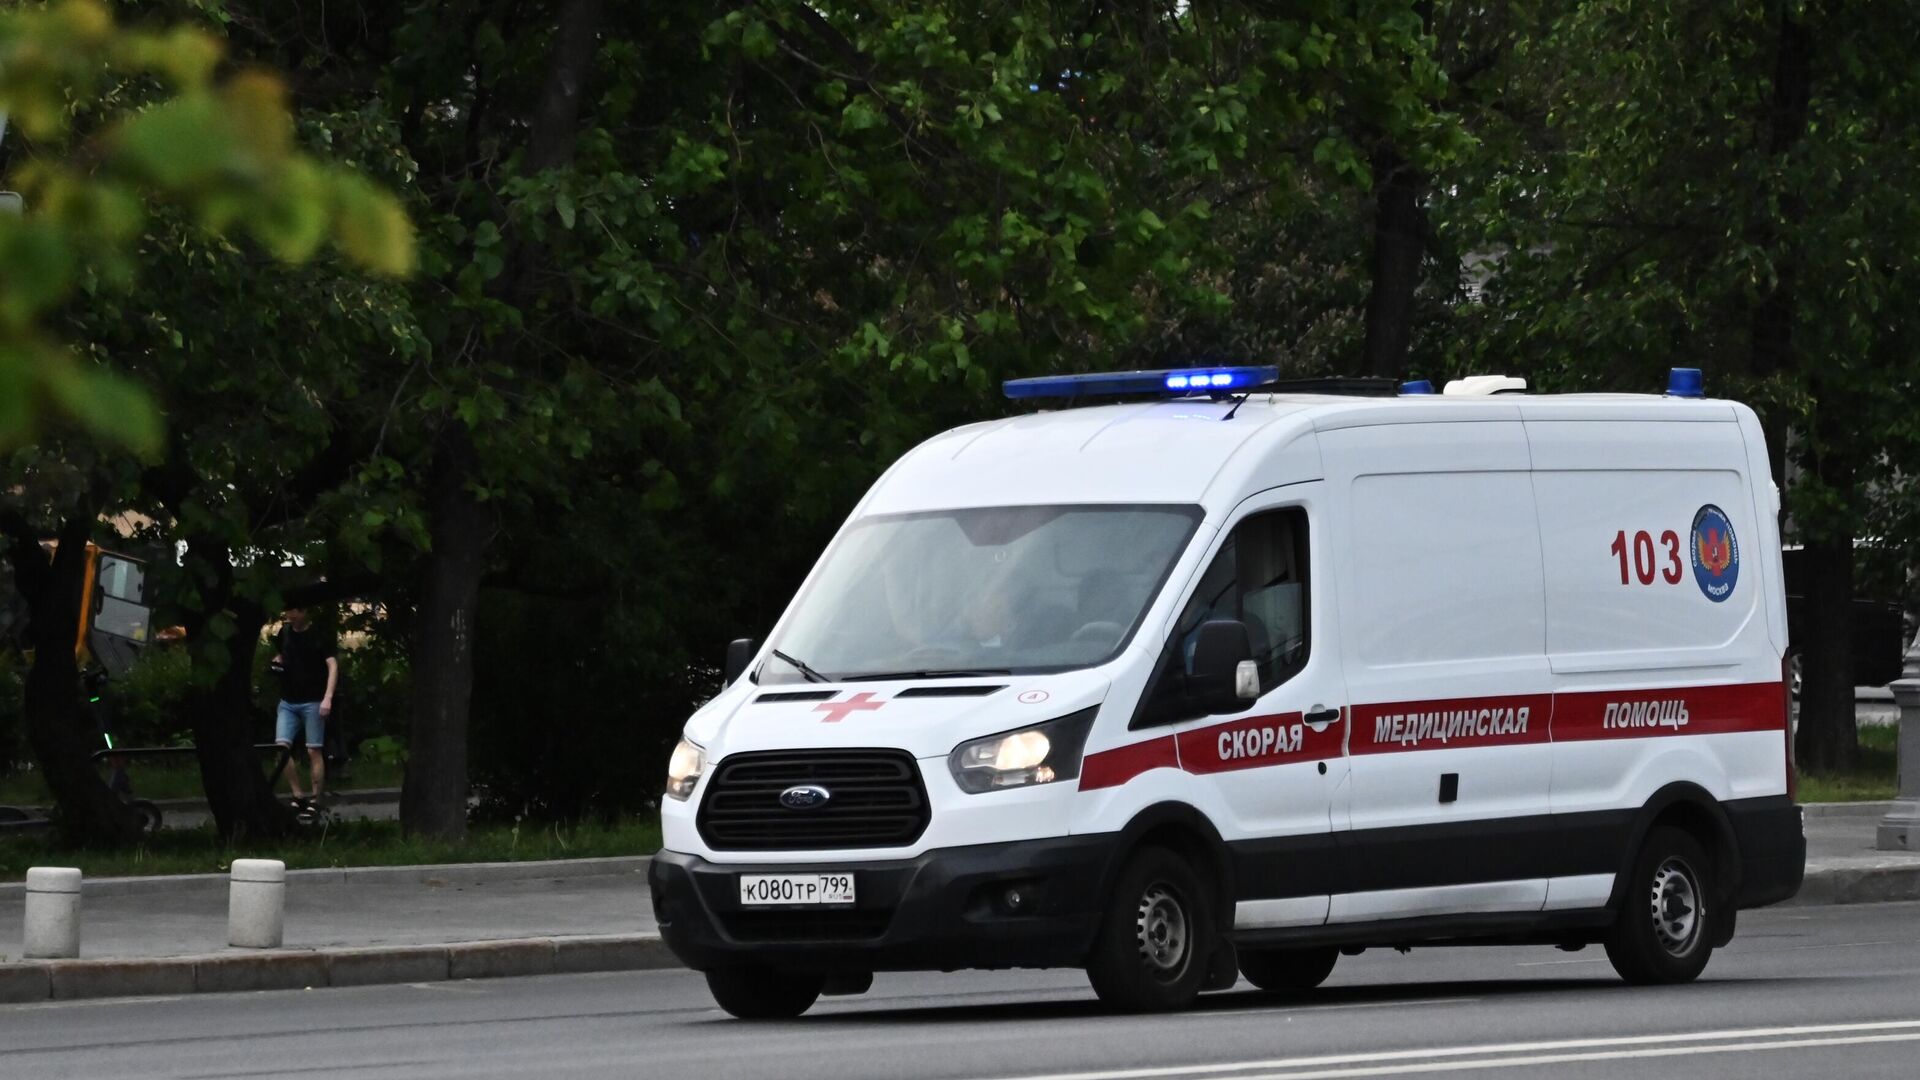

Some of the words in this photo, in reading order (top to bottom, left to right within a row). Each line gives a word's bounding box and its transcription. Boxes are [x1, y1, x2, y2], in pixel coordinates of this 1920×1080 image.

[1611, 530, 1683, 585] 103
[1218, 724, 1303, 760] СКОРАЯ
[1373, 707, 1530, 747] МЕДИЦИНСКАЯ
[1603, 700, 1689, 730] ПОМОЩЬ
[820, 877, 849, 893] 799
